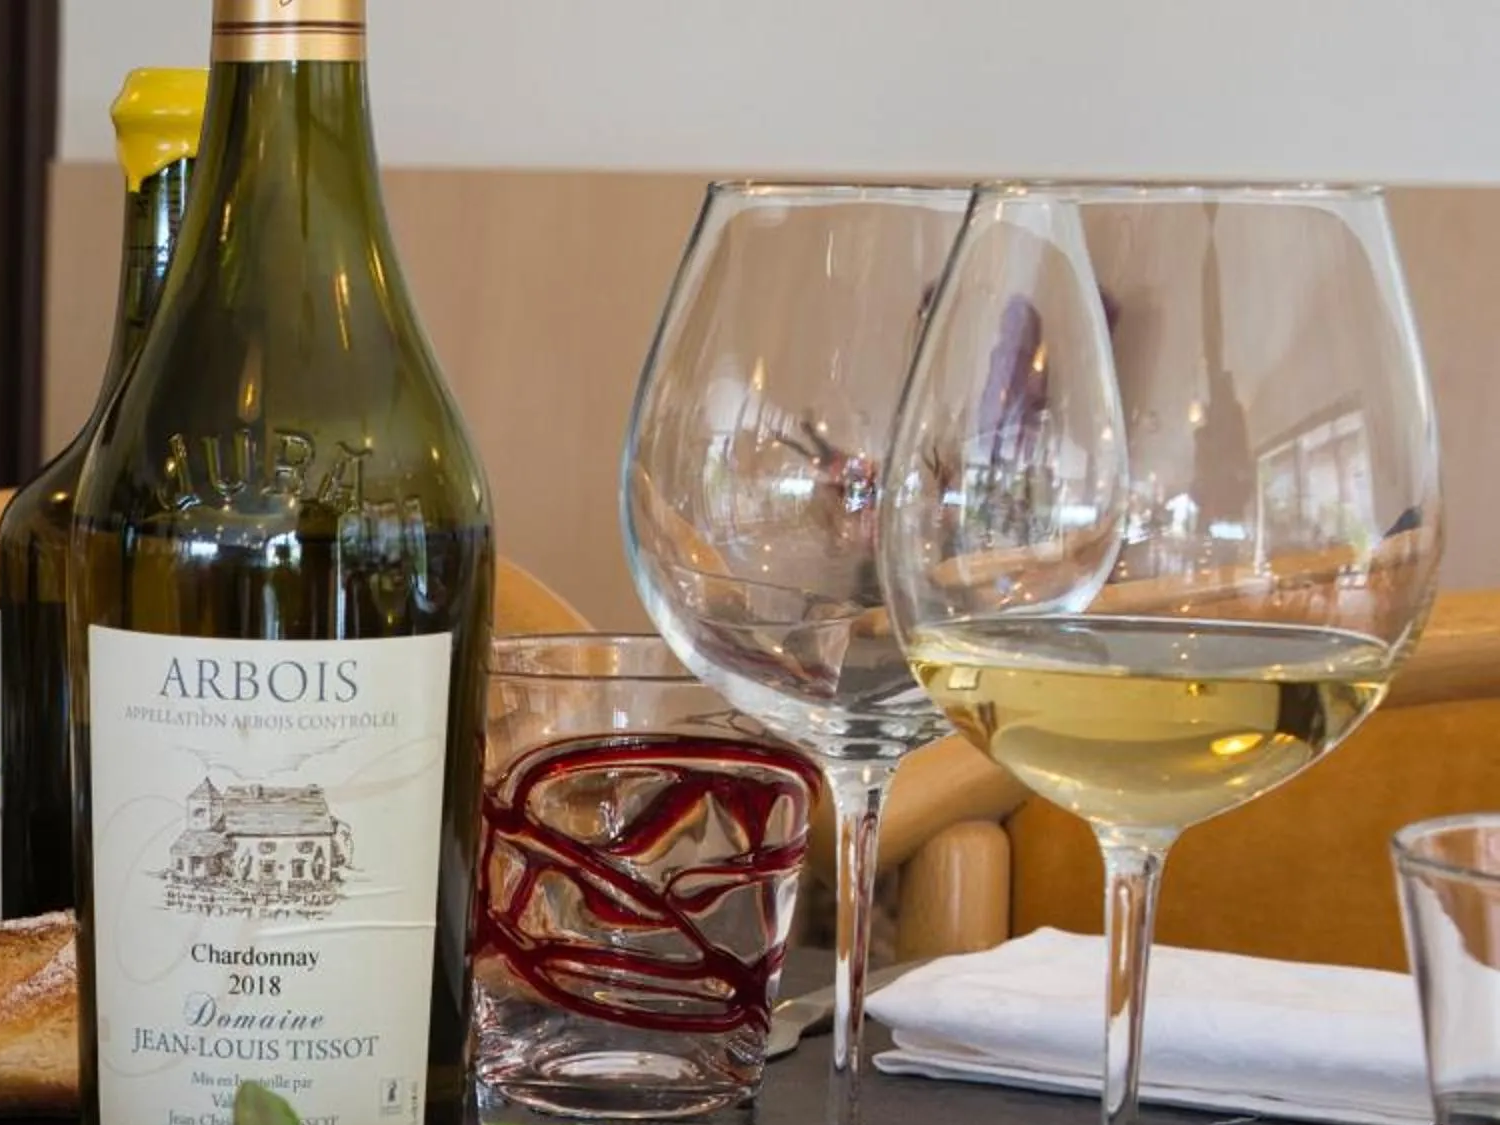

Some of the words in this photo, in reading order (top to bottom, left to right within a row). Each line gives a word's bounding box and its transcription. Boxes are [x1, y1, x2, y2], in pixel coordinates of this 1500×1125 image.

[156, 427, 373, 513] JURA
[159, 657, 359, 703] ARBOIS
[124, 704, 227, 729] APPELLATION
[191, 943, 320, 971] Chardonnay
[228, 974, 282, 997] 2018
[184, 991, 325, 1031] Domaine
[131, 1028, 280, 1060] JEAN-LOUIS
[286, 1035, 380, 1061] TISSOT
